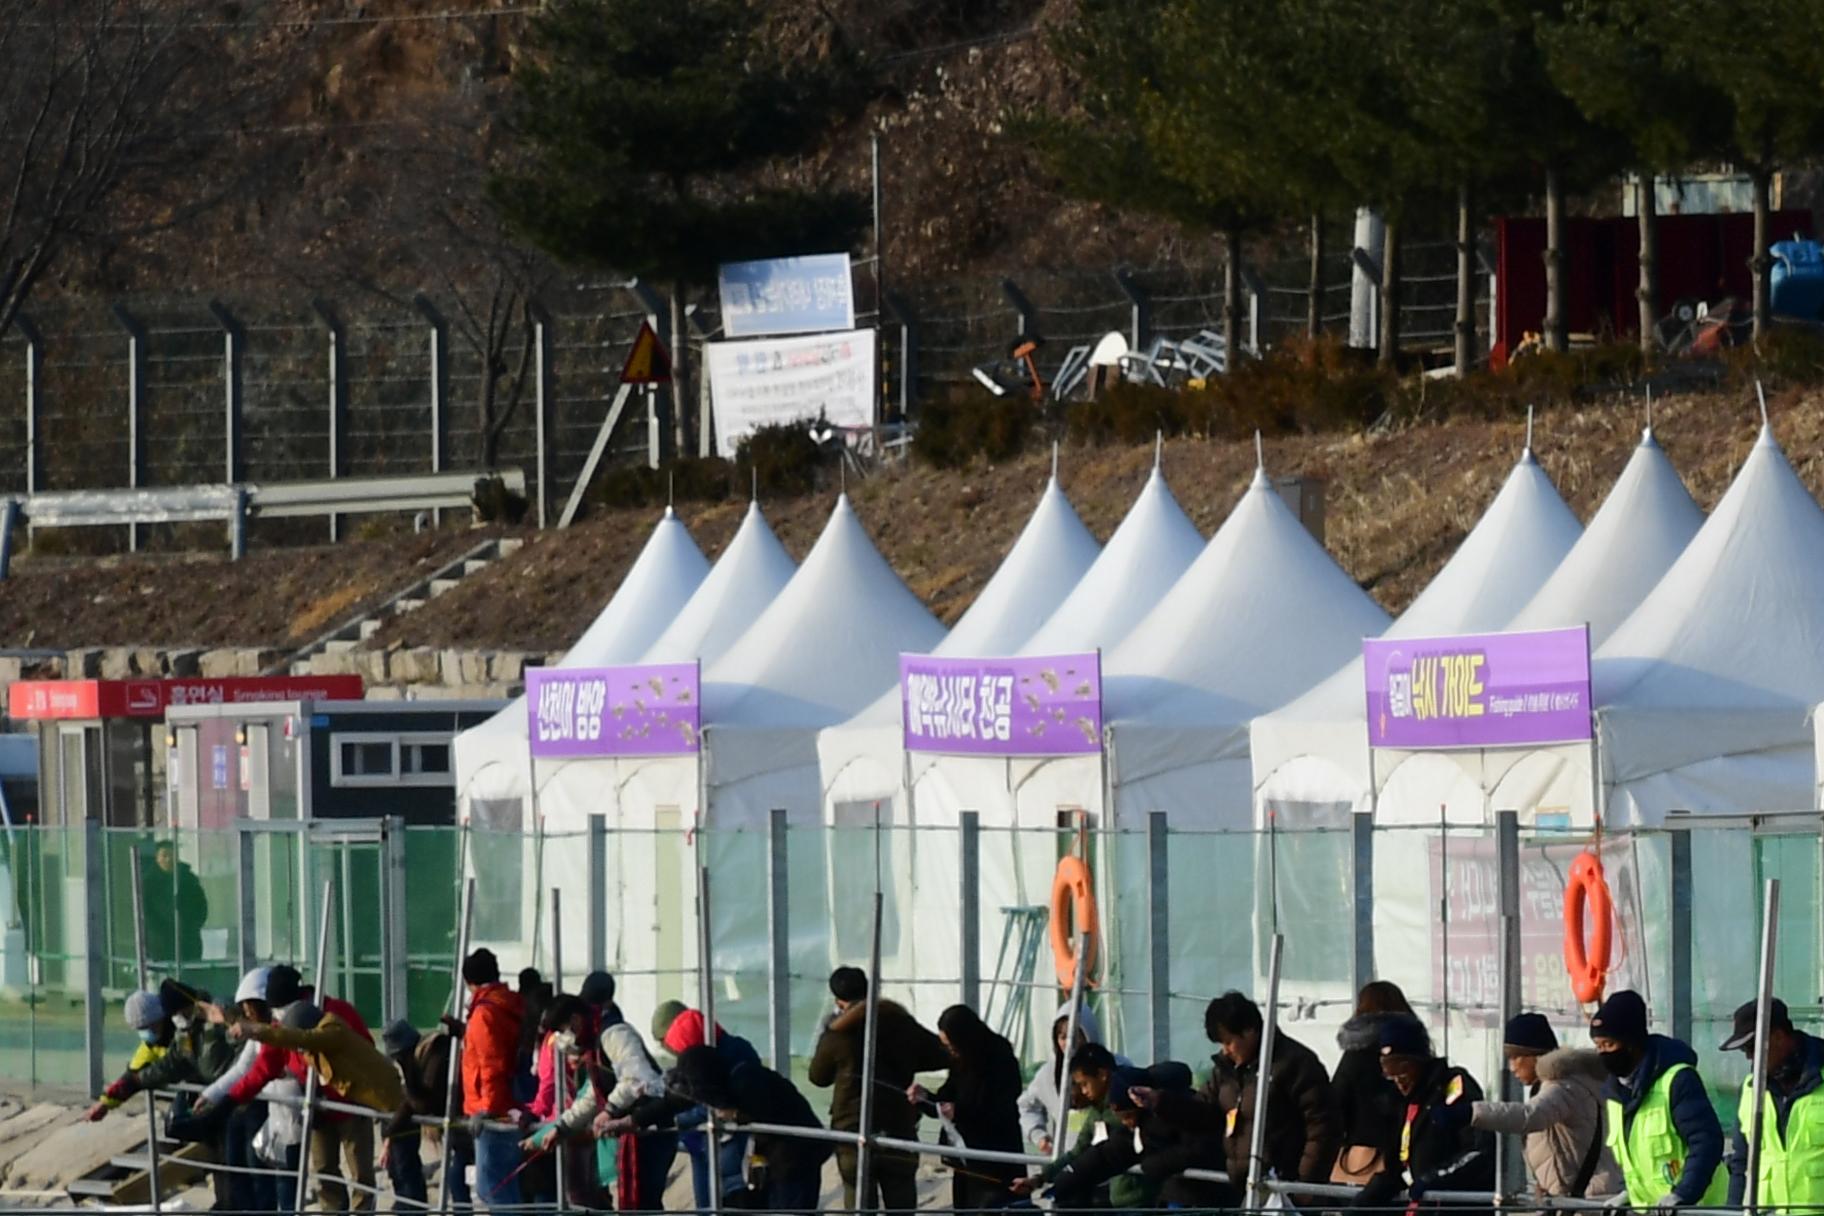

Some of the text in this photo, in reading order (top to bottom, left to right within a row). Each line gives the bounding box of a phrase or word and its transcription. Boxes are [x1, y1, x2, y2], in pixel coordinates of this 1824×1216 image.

[171, 684, 224, 704] 흡연실
[538, 681, 576, 742] 산천어
[1411, 656, 1438, 720] 낚시
[1440, 653, 1485, 718] 가이드
